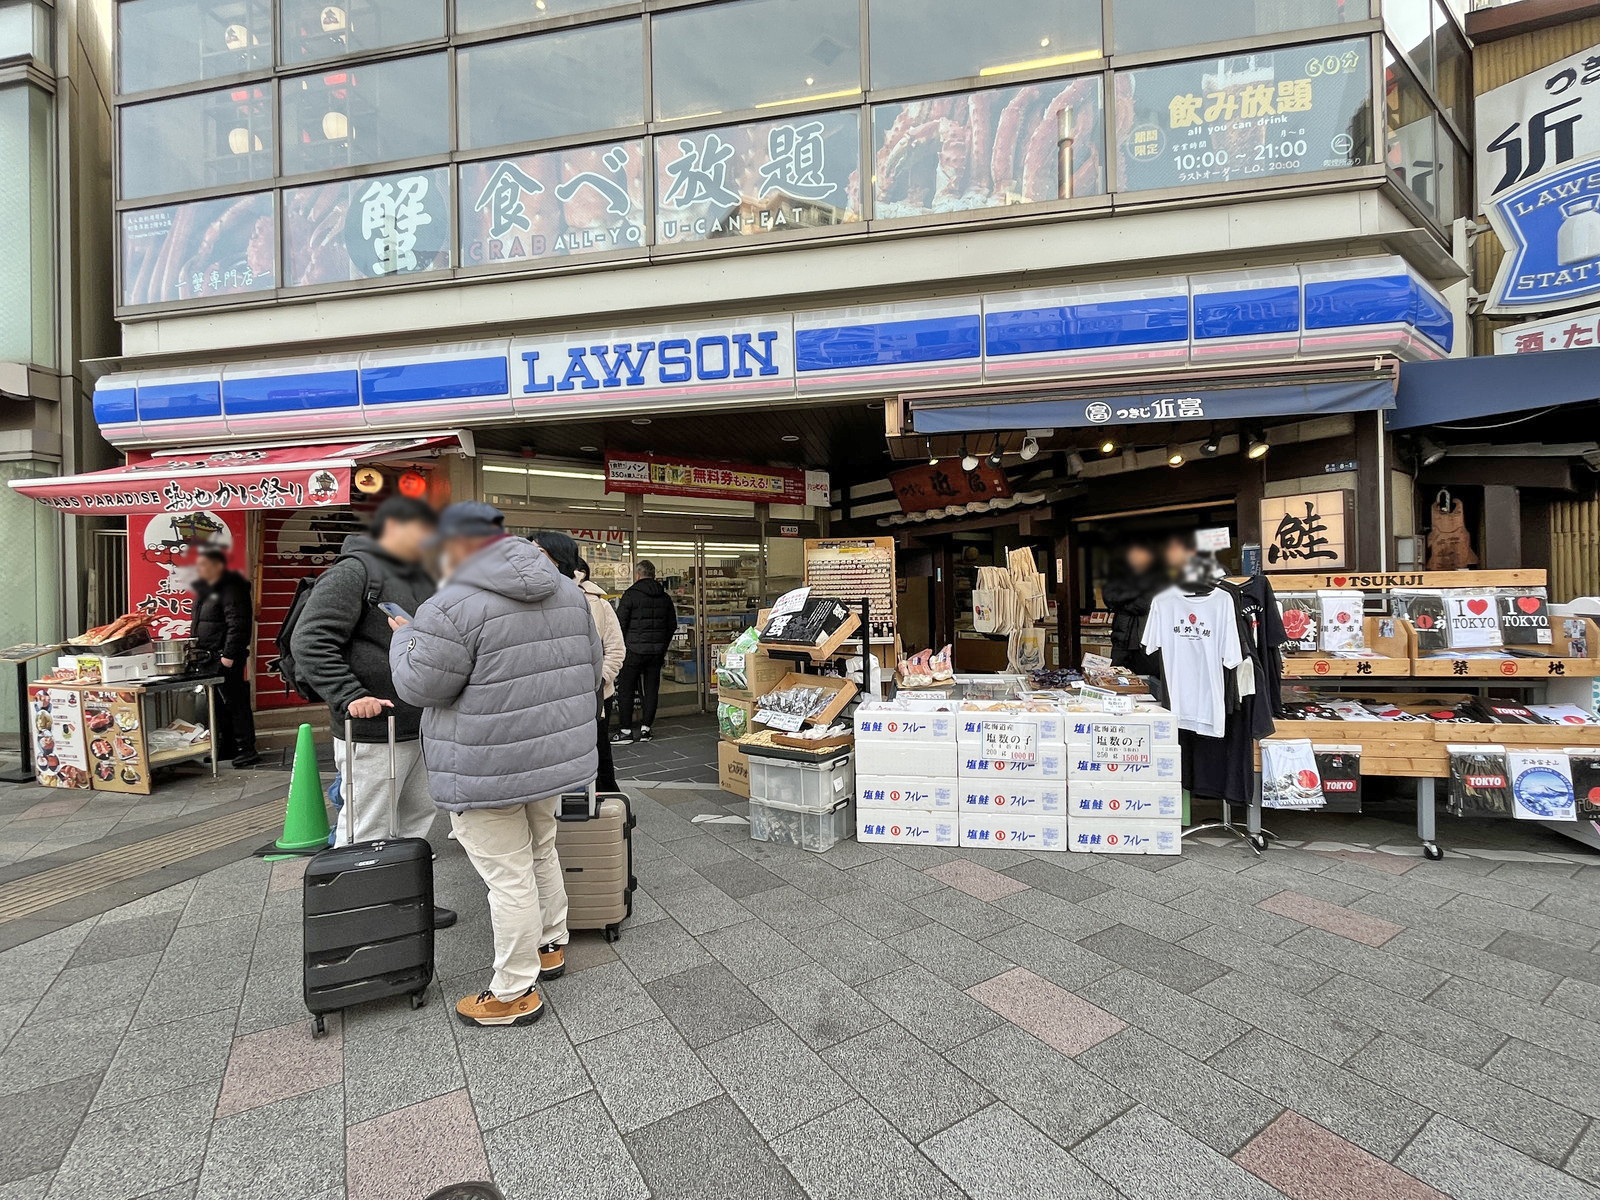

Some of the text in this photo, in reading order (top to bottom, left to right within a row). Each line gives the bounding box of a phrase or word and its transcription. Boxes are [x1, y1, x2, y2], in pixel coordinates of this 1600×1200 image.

[1168, 78, 1313, 129] 飲み放題
[1187, 115, 1288, 136] all you can drink
[1173, 150, 1229, 171] 10:00
[1253, 140, 1308, 161] 21:00
[1269, 161, 1300, 171] 20:00
[475, 126, 837, 239] 食べ放題
[358, 175, 434, 276] 蟹
[469, 236, 548, 263] CRAB
[1514, 319, 1600, 354] 酒・た
[521, 330, 779, 393] LAWSON
[83, 491, 160, 507] PARADISE
[1267, 501, 1339, 565] 鮭
[1326, 575, 1424, 587] I TSUKIJI
[1453, 618, 1496, 629] TOKYO
[1503, 614, 1548, 627] TOKYO
[1357, 661, 1373, 675] 地
[1549, 661, 1565, 675] 地
[1495, 706, 1528, 716] TOKYO
[861, 721, 883, 732] 塩鮭
[902, 722, 927, 733] フィレー
[1122, 753, 1149, 764] 1500円
[966, 760, 989, 771] 塩鮭
[1077, 761, 1101, 772] 塩鮭
[1326, 781, 1354, 790] TOKYO
[1470, 776, 1502, 786] TOKYO
[863, 790, 885, 801] 塩鮭
[904, 791, 929, 801] フィレー
[966, 794, 989, 805] 塩鮭
[1009, 795, 1036, 805] フィレー
[1079, 800, 1103, 811] 塩鮭
[1125, 801, 1151, 811] フィレー
[864, 825, 886, 836] 塩鮭
[905, 826, 930, 836] フィレー
[967, 830, 990, 841] 塩鮭
[1010, 831, 1036, 841] フィレー
[1077, 834, 1101, 845] 塩鮭
[1123, 835, 1150, 845] フィレー
